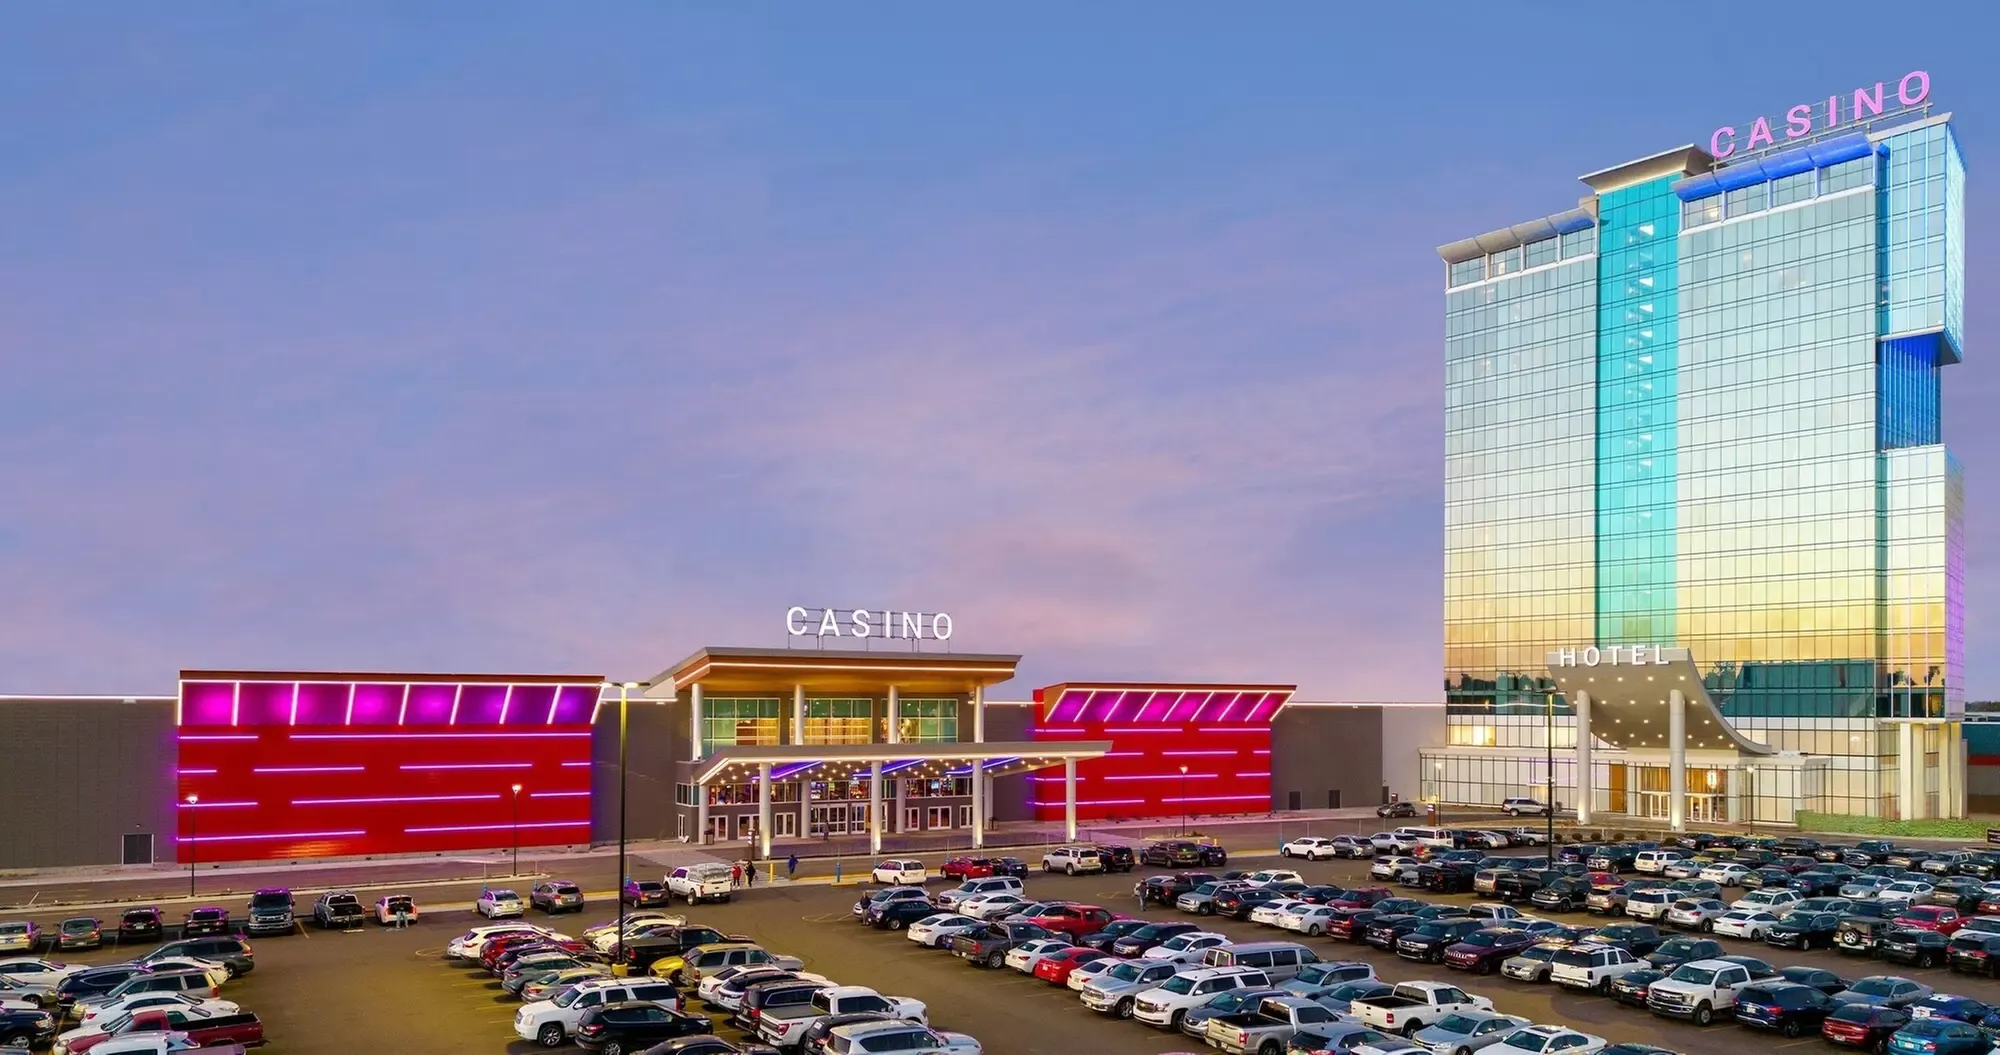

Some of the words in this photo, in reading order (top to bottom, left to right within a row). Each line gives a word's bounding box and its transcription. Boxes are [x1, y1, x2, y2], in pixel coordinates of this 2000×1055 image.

[1710, 70, 1930, 158] CASINO
[786, 606, 953, 640] CASINO
[1559, 644, 1670, 667] HOTEL
